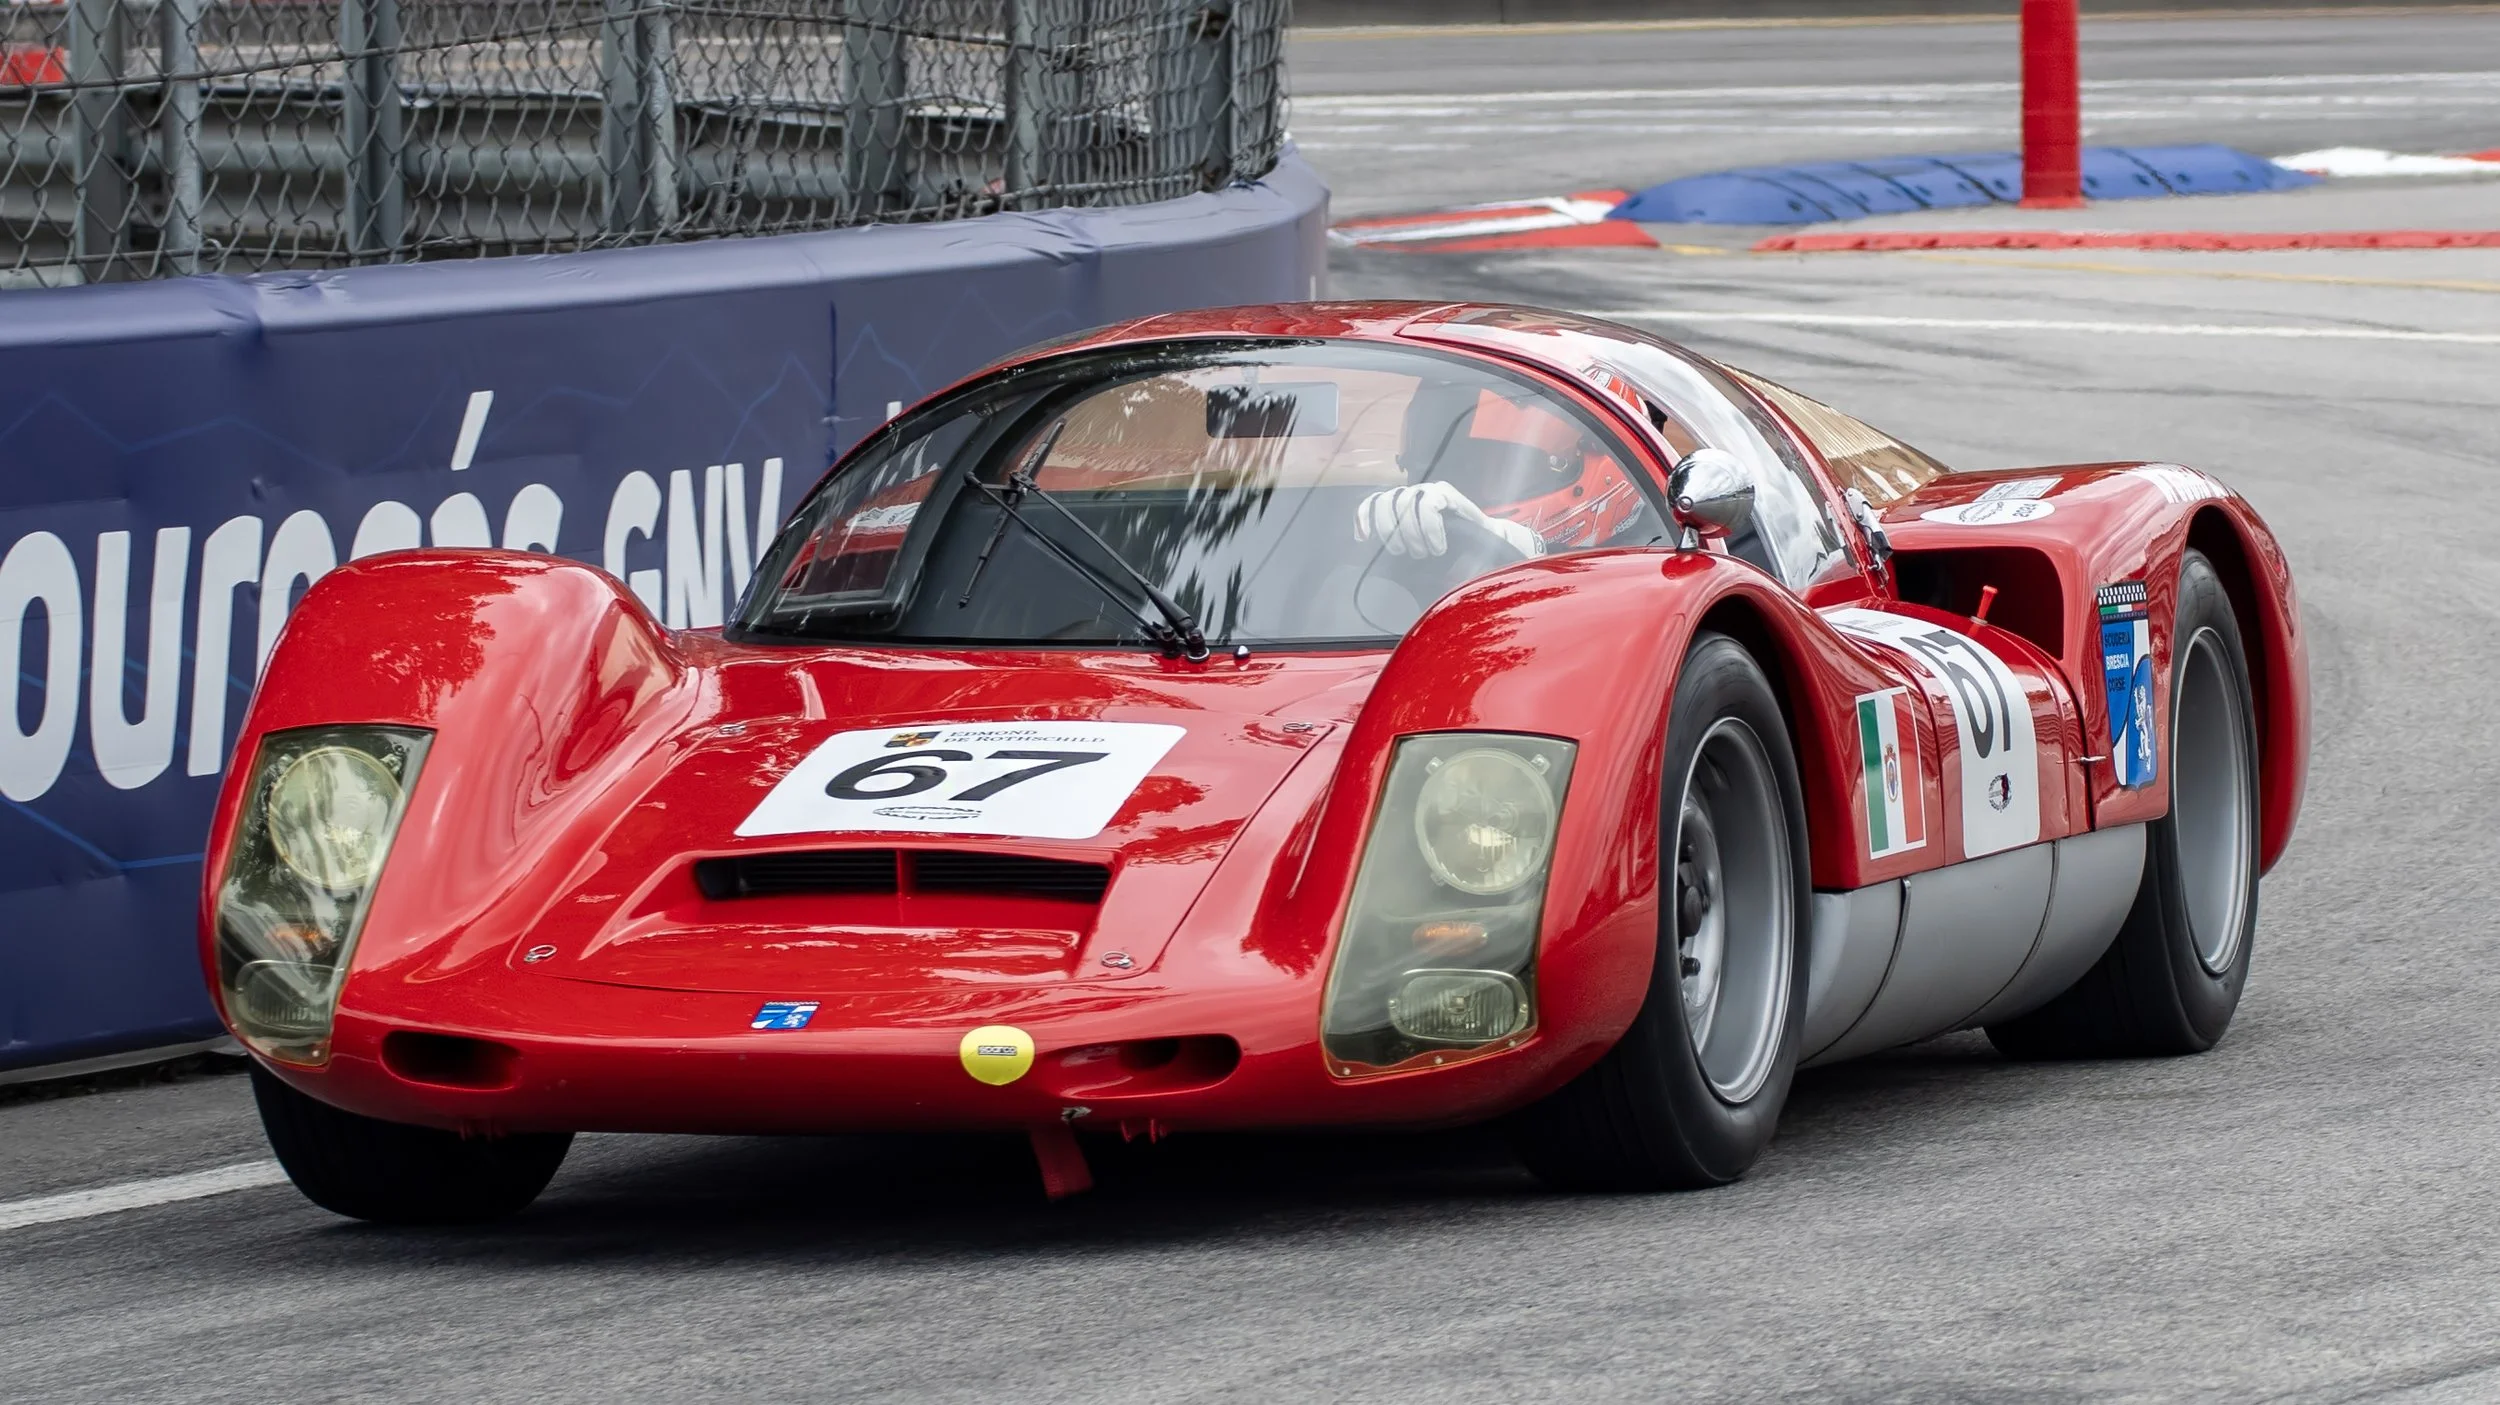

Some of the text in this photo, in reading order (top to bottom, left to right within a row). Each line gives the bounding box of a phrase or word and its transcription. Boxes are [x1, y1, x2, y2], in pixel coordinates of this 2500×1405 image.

[603, 457, 783, 629] GNV
[1900, 630, 2011, 759] 67
[2105, 653, 2130, 671] BRESCIA
[825, 749, 1111, 801] 67
